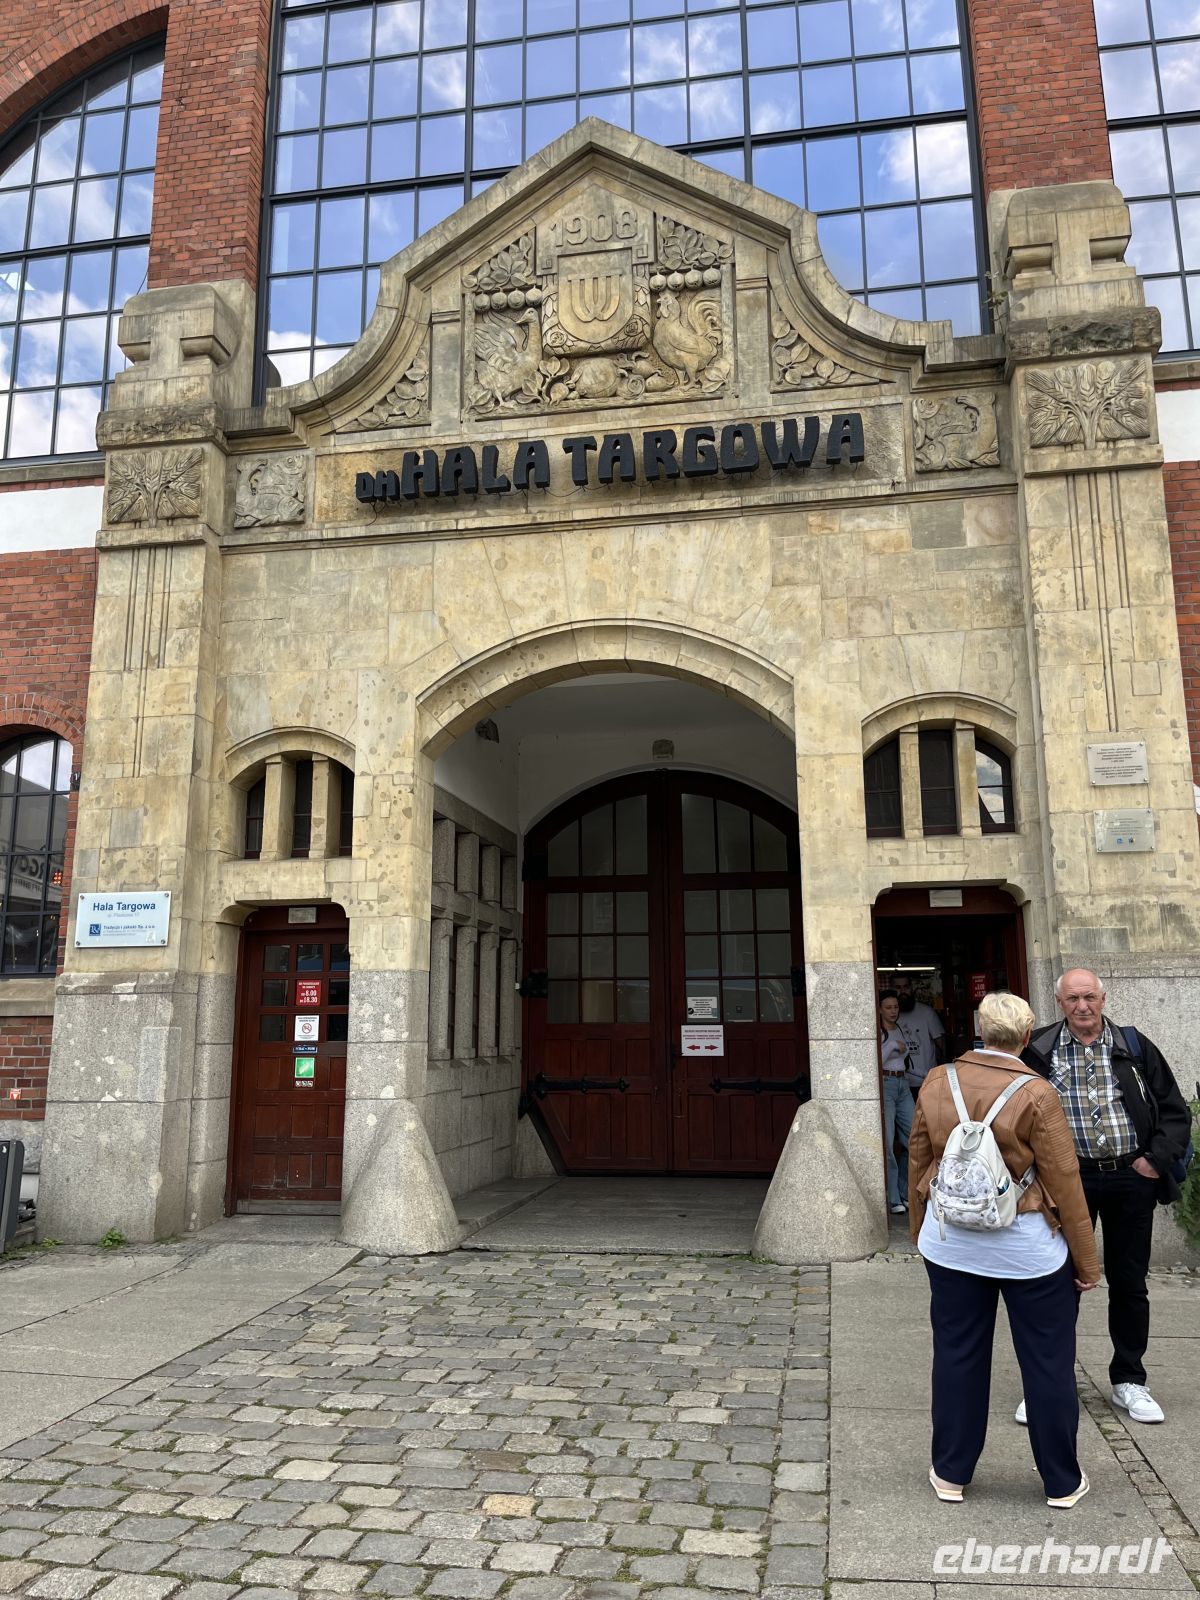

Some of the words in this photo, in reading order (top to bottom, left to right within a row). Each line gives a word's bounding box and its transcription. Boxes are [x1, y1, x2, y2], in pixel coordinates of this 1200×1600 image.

[551, 211, 638, 248] 1908
[355, 470, 400, 504] DH
[401, 440, 551, 500] HALA
[562, 412, 865, 487] TARGOWA
[93, 902, 114, 911] Hala
[116, 901, 156, 912] Targowa
